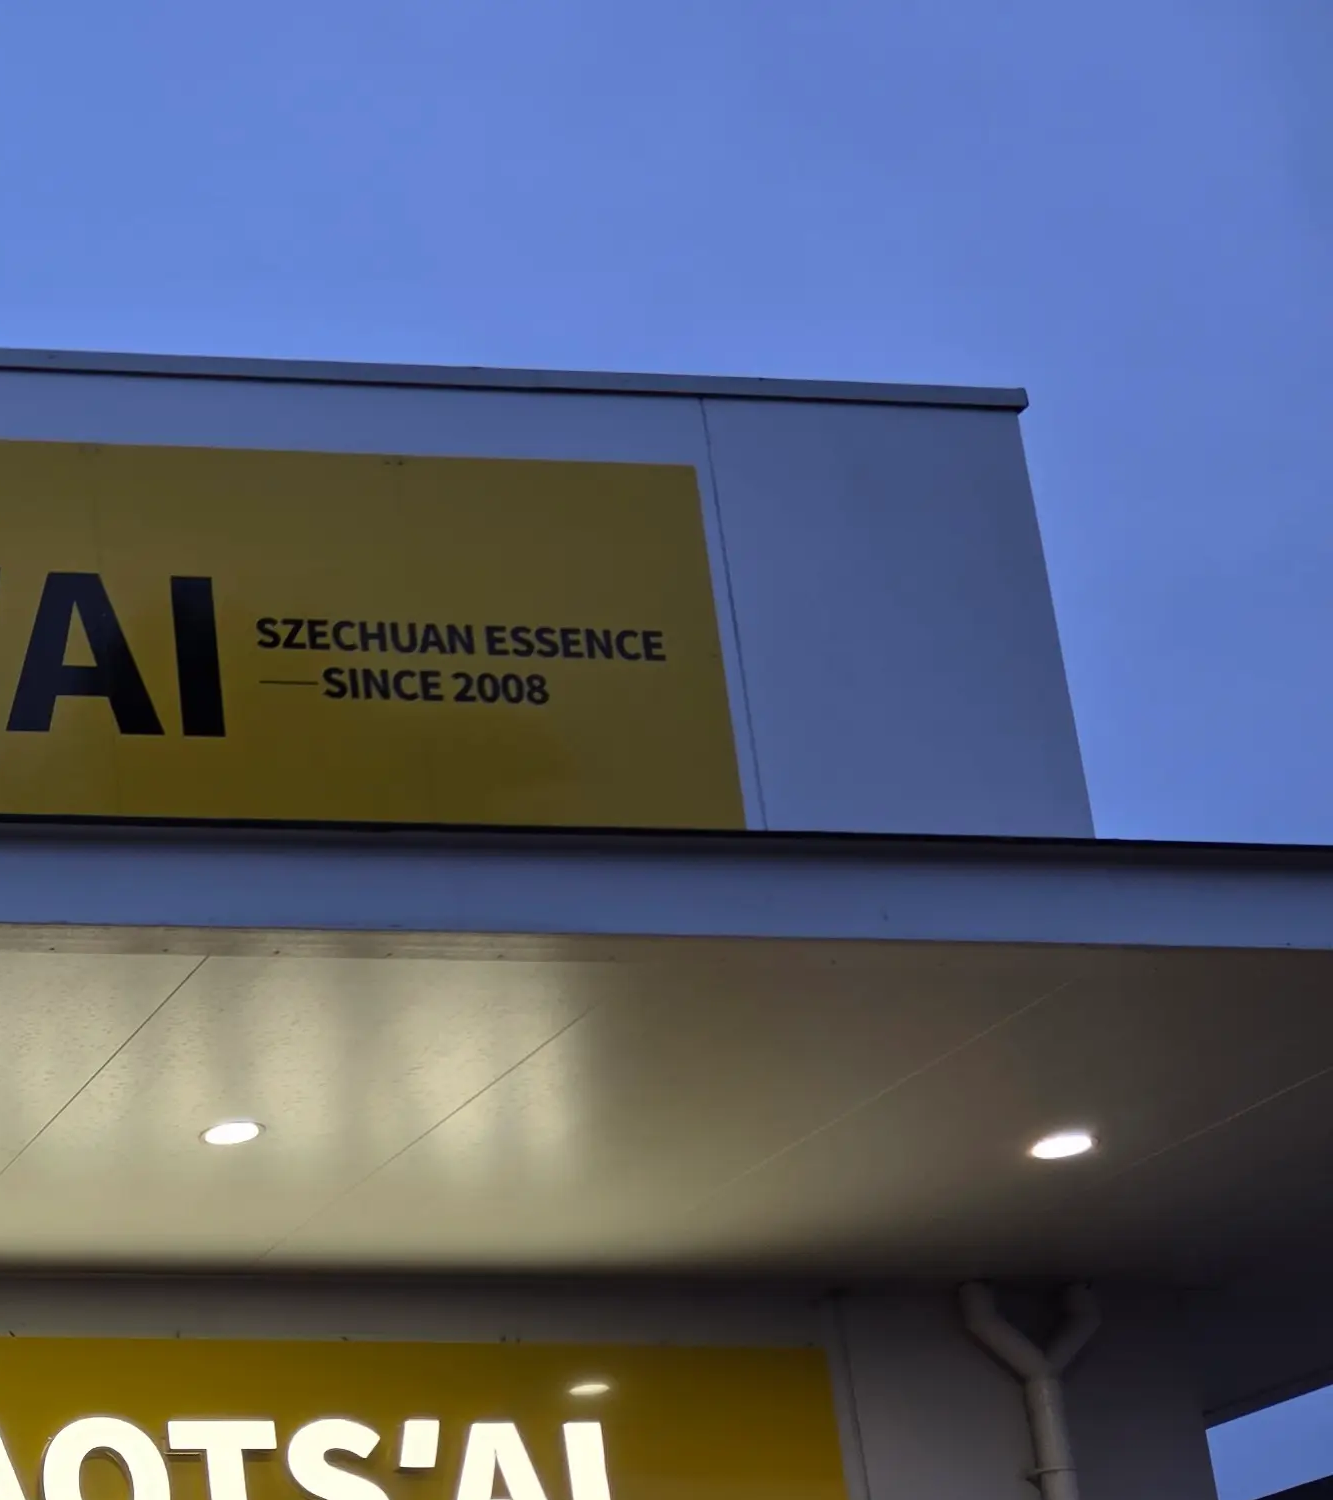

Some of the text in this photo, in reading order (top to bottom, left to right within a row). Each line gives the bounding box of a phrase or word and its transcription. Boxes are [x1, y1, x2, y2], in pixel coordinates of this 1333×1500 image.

[255, 617, 667, 662] SZECHUAN ESSENCE
[322, 667, 550, 706] SINCE 2008
